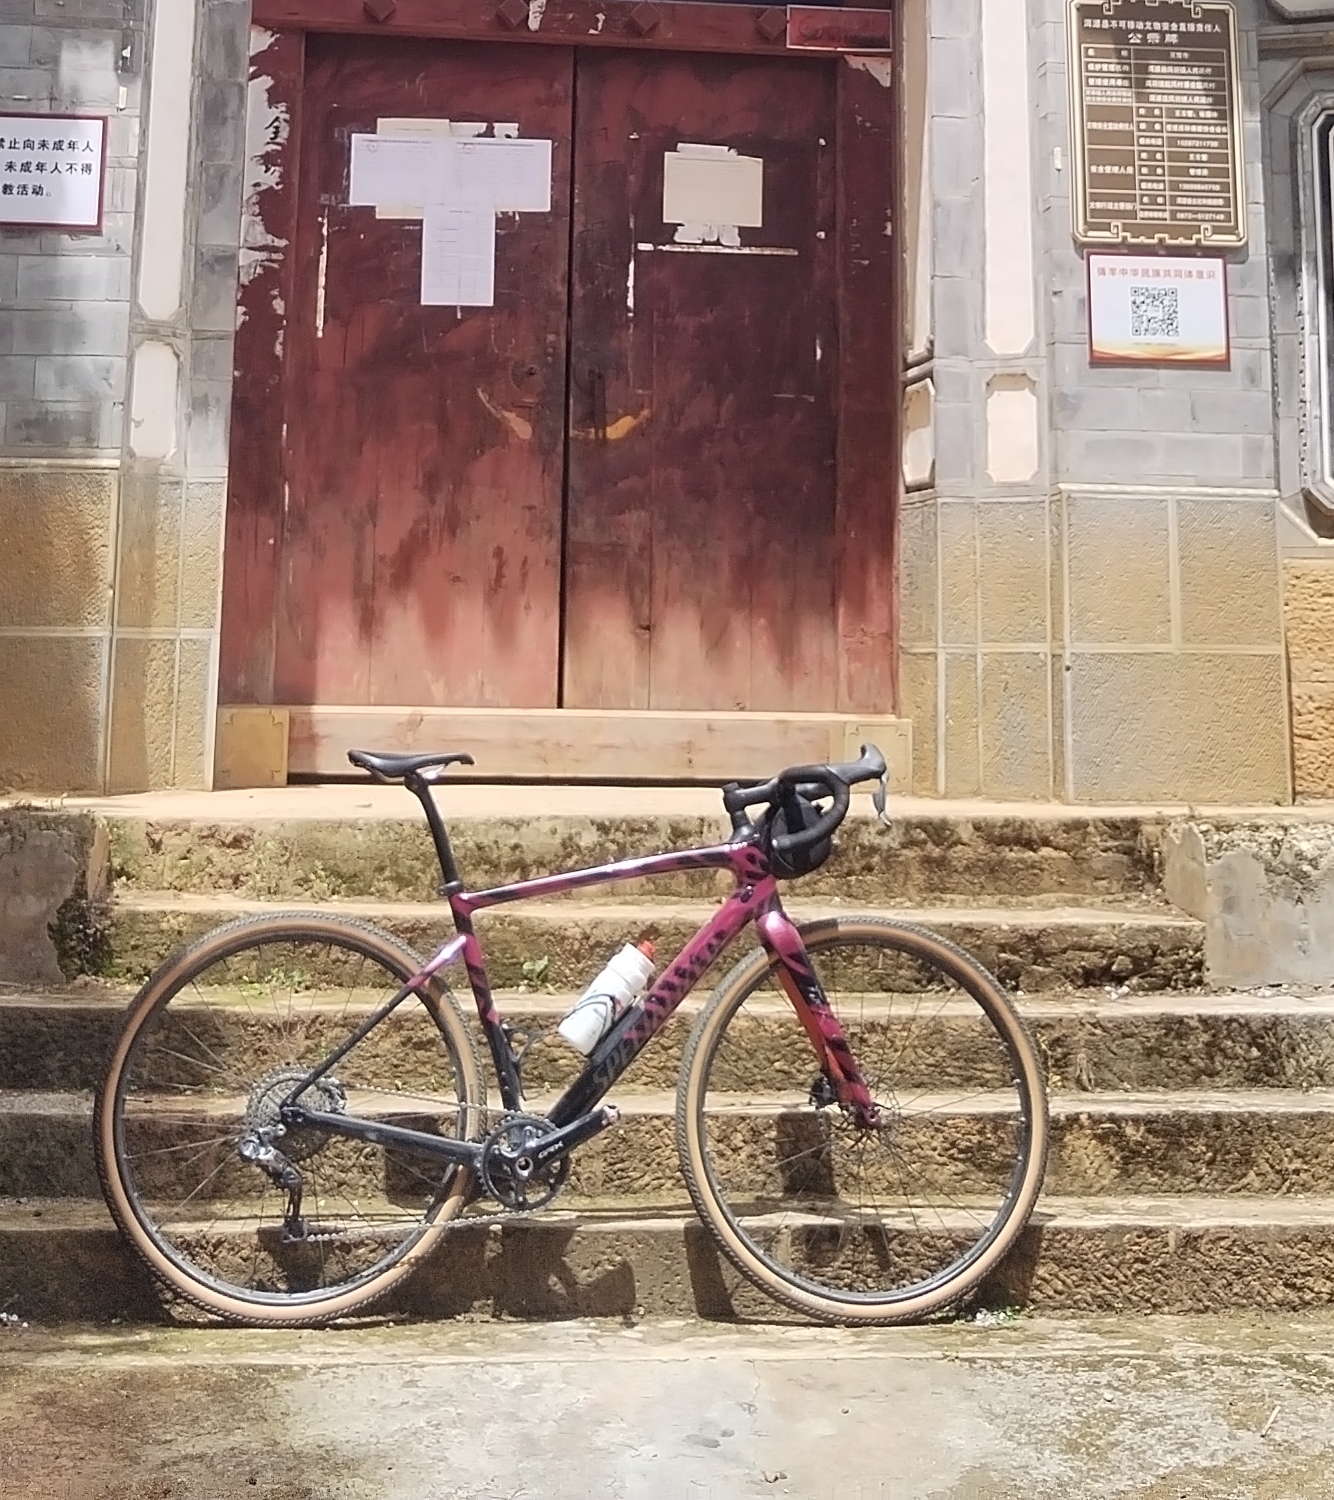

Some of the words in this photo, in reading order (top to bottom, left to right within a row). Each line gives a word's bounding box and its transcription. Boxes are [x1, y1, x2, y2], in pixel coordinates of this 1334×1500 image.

[1096, 266, 1216, 280] 铸牢中华民族共同体意识
